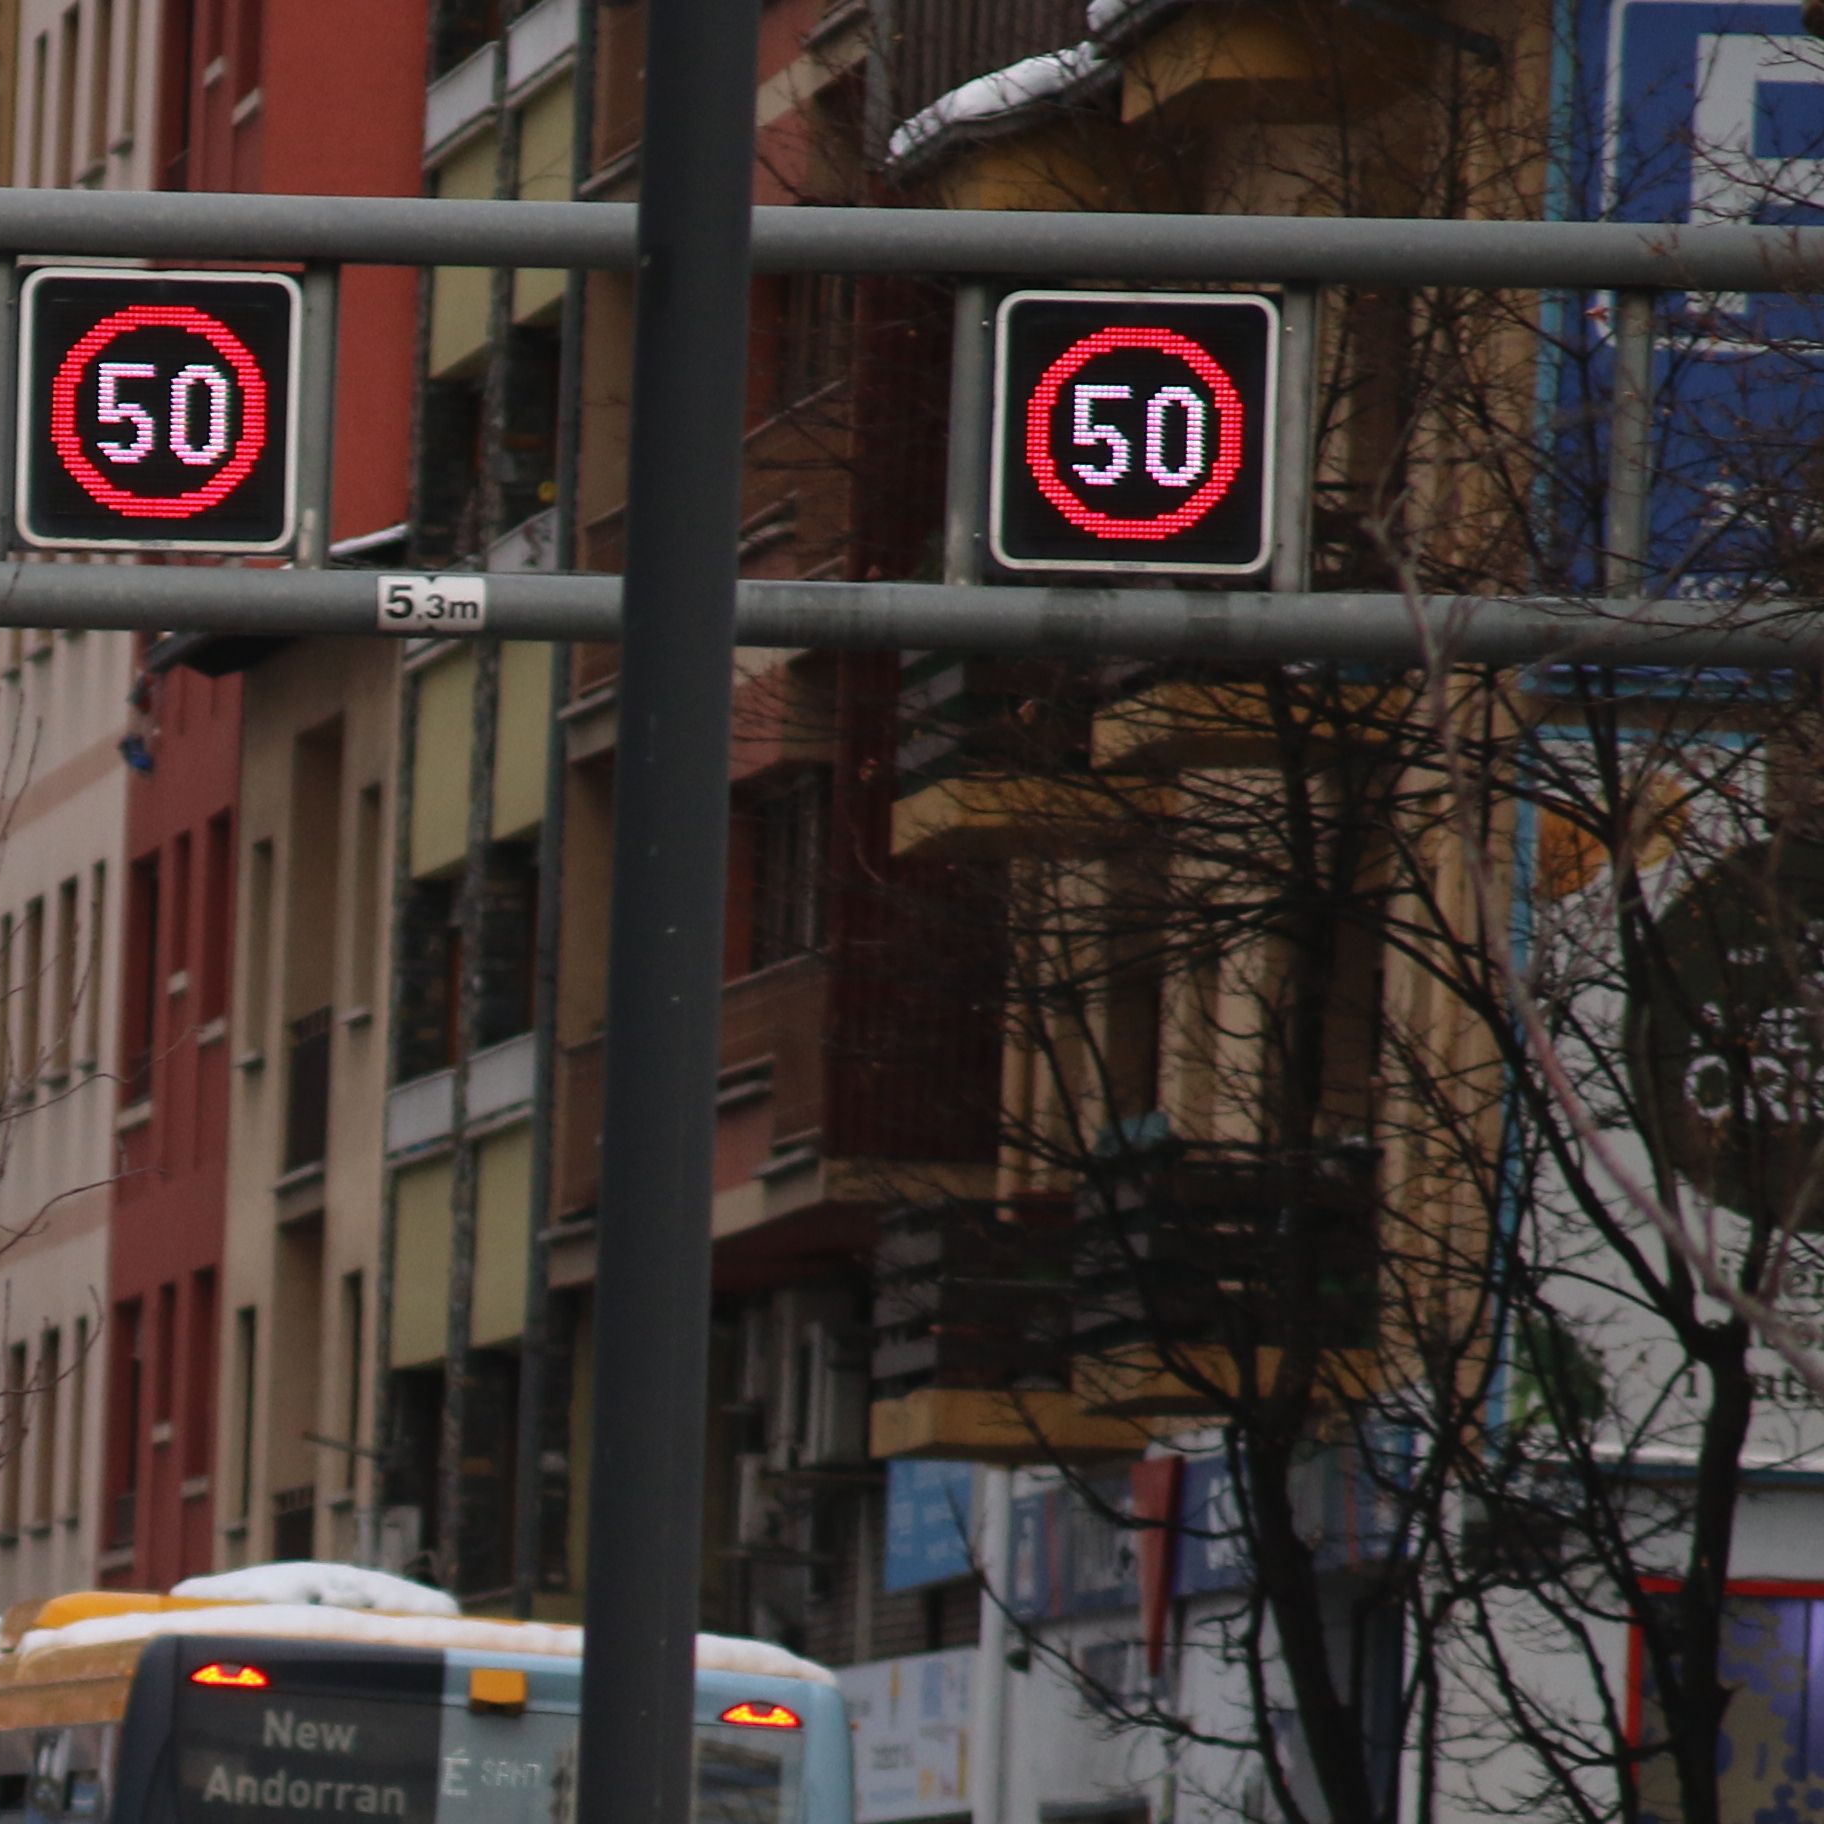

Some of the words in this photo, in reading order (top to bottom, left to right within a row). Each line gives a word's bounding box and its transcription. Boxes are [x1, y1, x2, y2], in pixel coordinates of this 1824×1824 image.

[96, 363, 232, 466] 50
[1071, 384, 1209, 487] 50
[385, 585, 479, 619] 5.3m
[263, 1709, 358, 1752] New
[203, 1764, 407, 1815] Andorran
